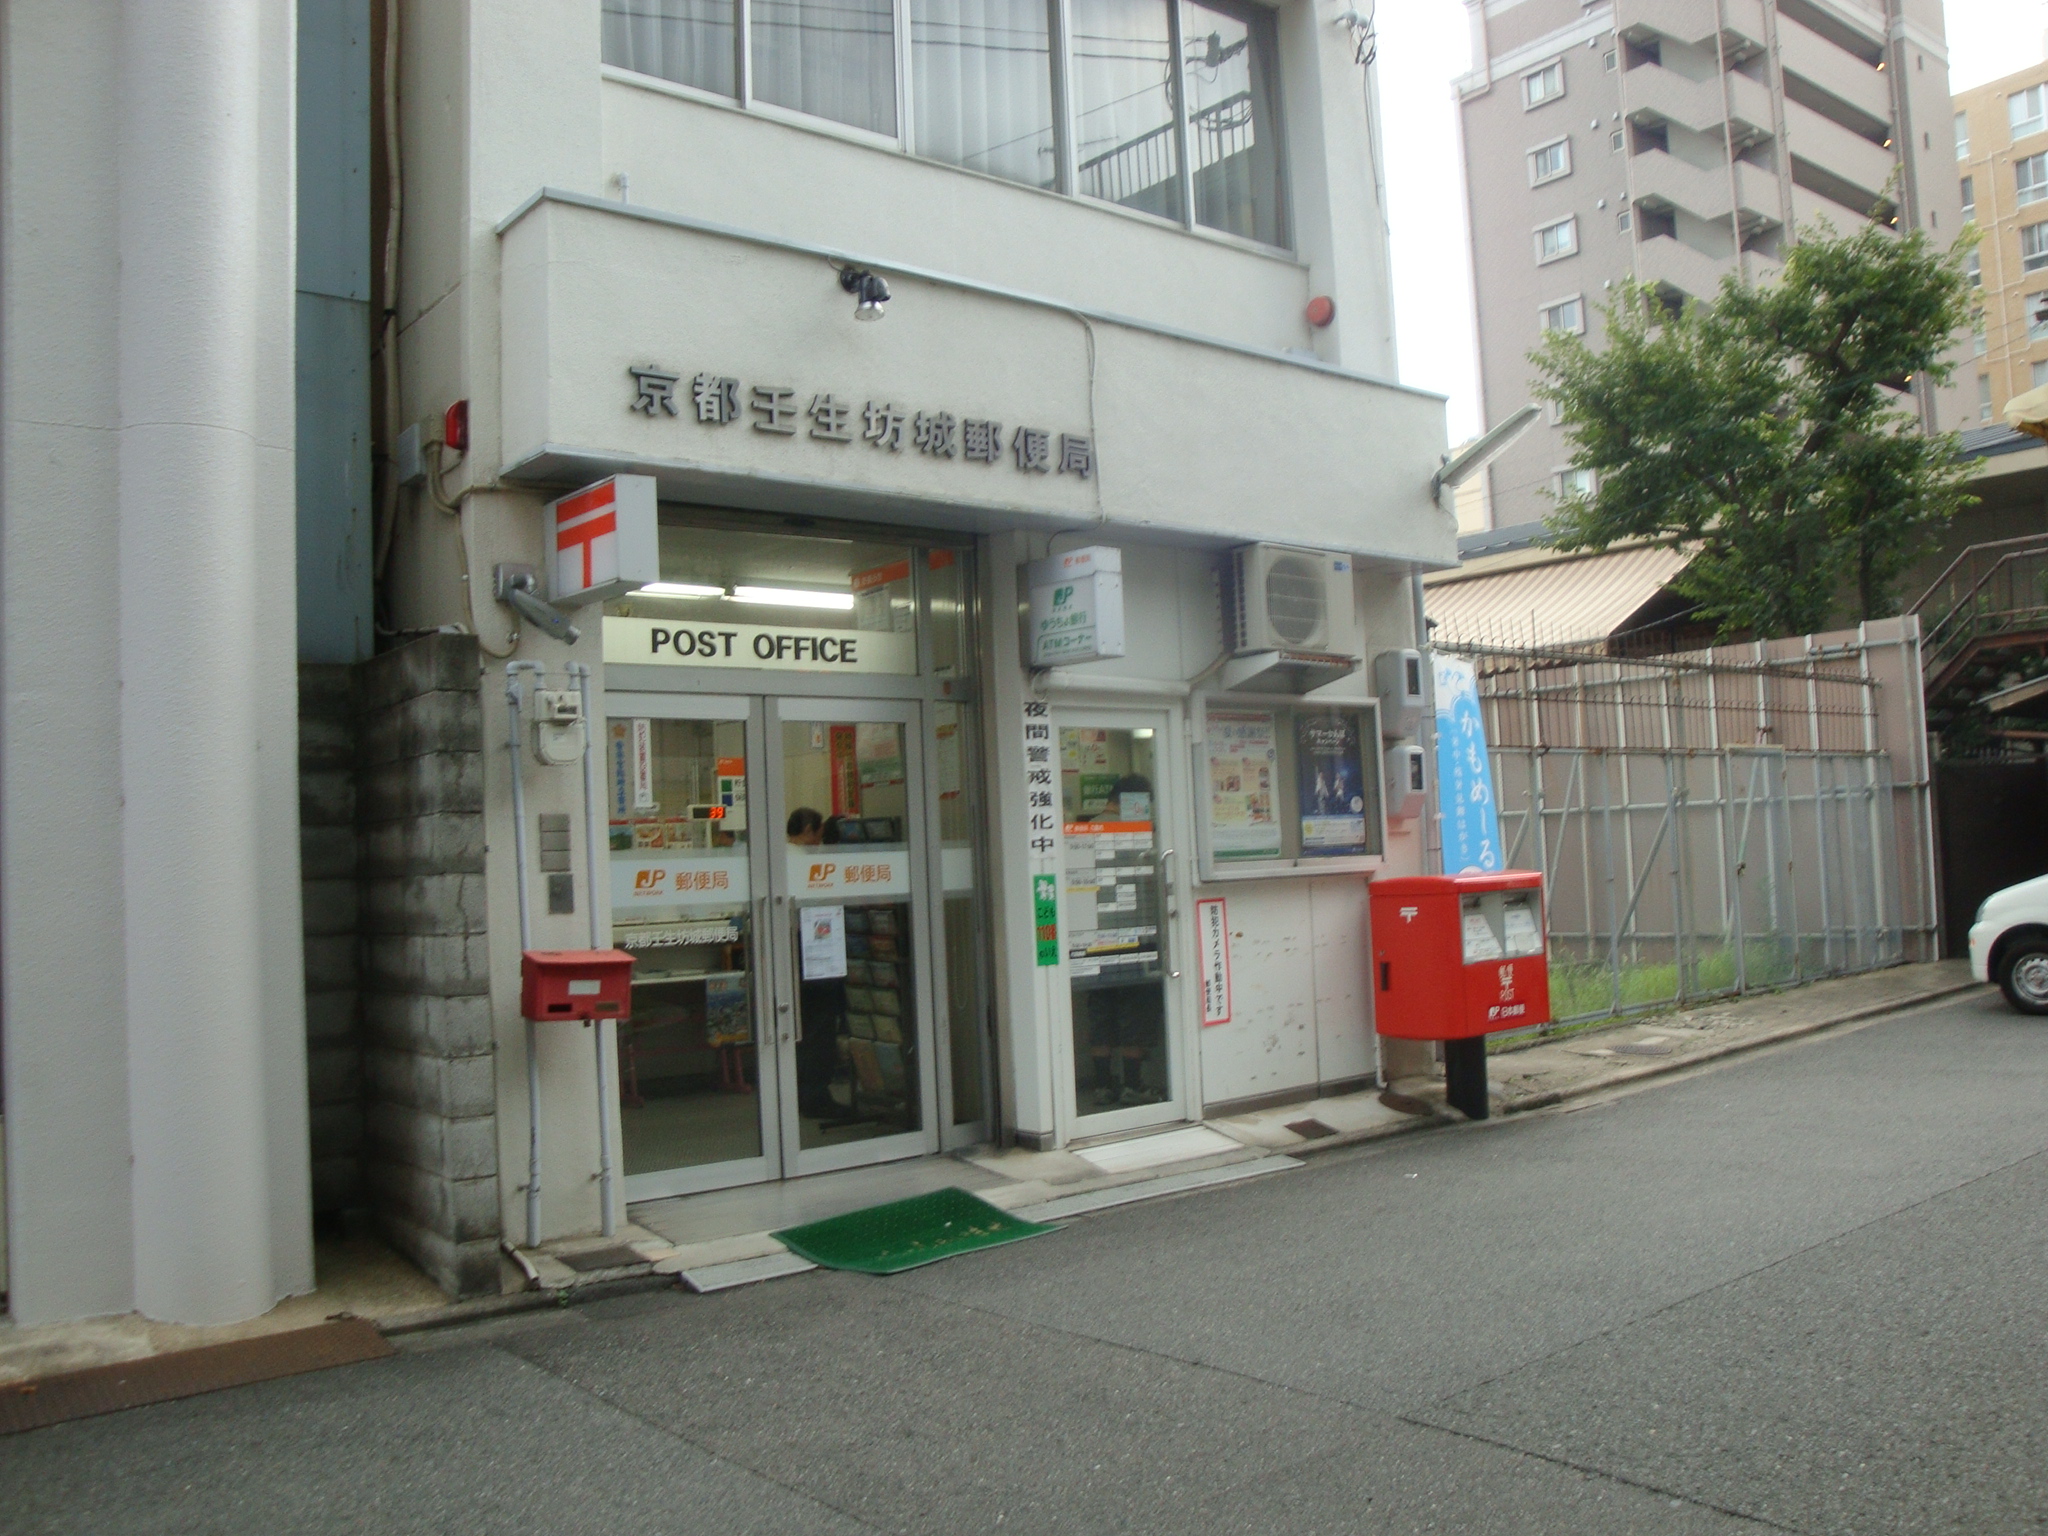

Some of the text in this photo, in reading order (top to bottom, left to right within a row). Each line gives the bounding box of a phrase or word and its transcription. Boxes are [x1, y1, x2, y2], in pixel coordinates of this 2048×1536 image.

[629, 364, 1095, 478] 京都壬生坊城郵便局
[651, 628, 858, 663] POST OFFICE
[1024, 701, 1054, 852] 夜間警戒強化中
[675, 870, 729, 891] 郵便局
[844, 864, 892, 883] 郵便局
[1038, 907, 1056, 919] こども
